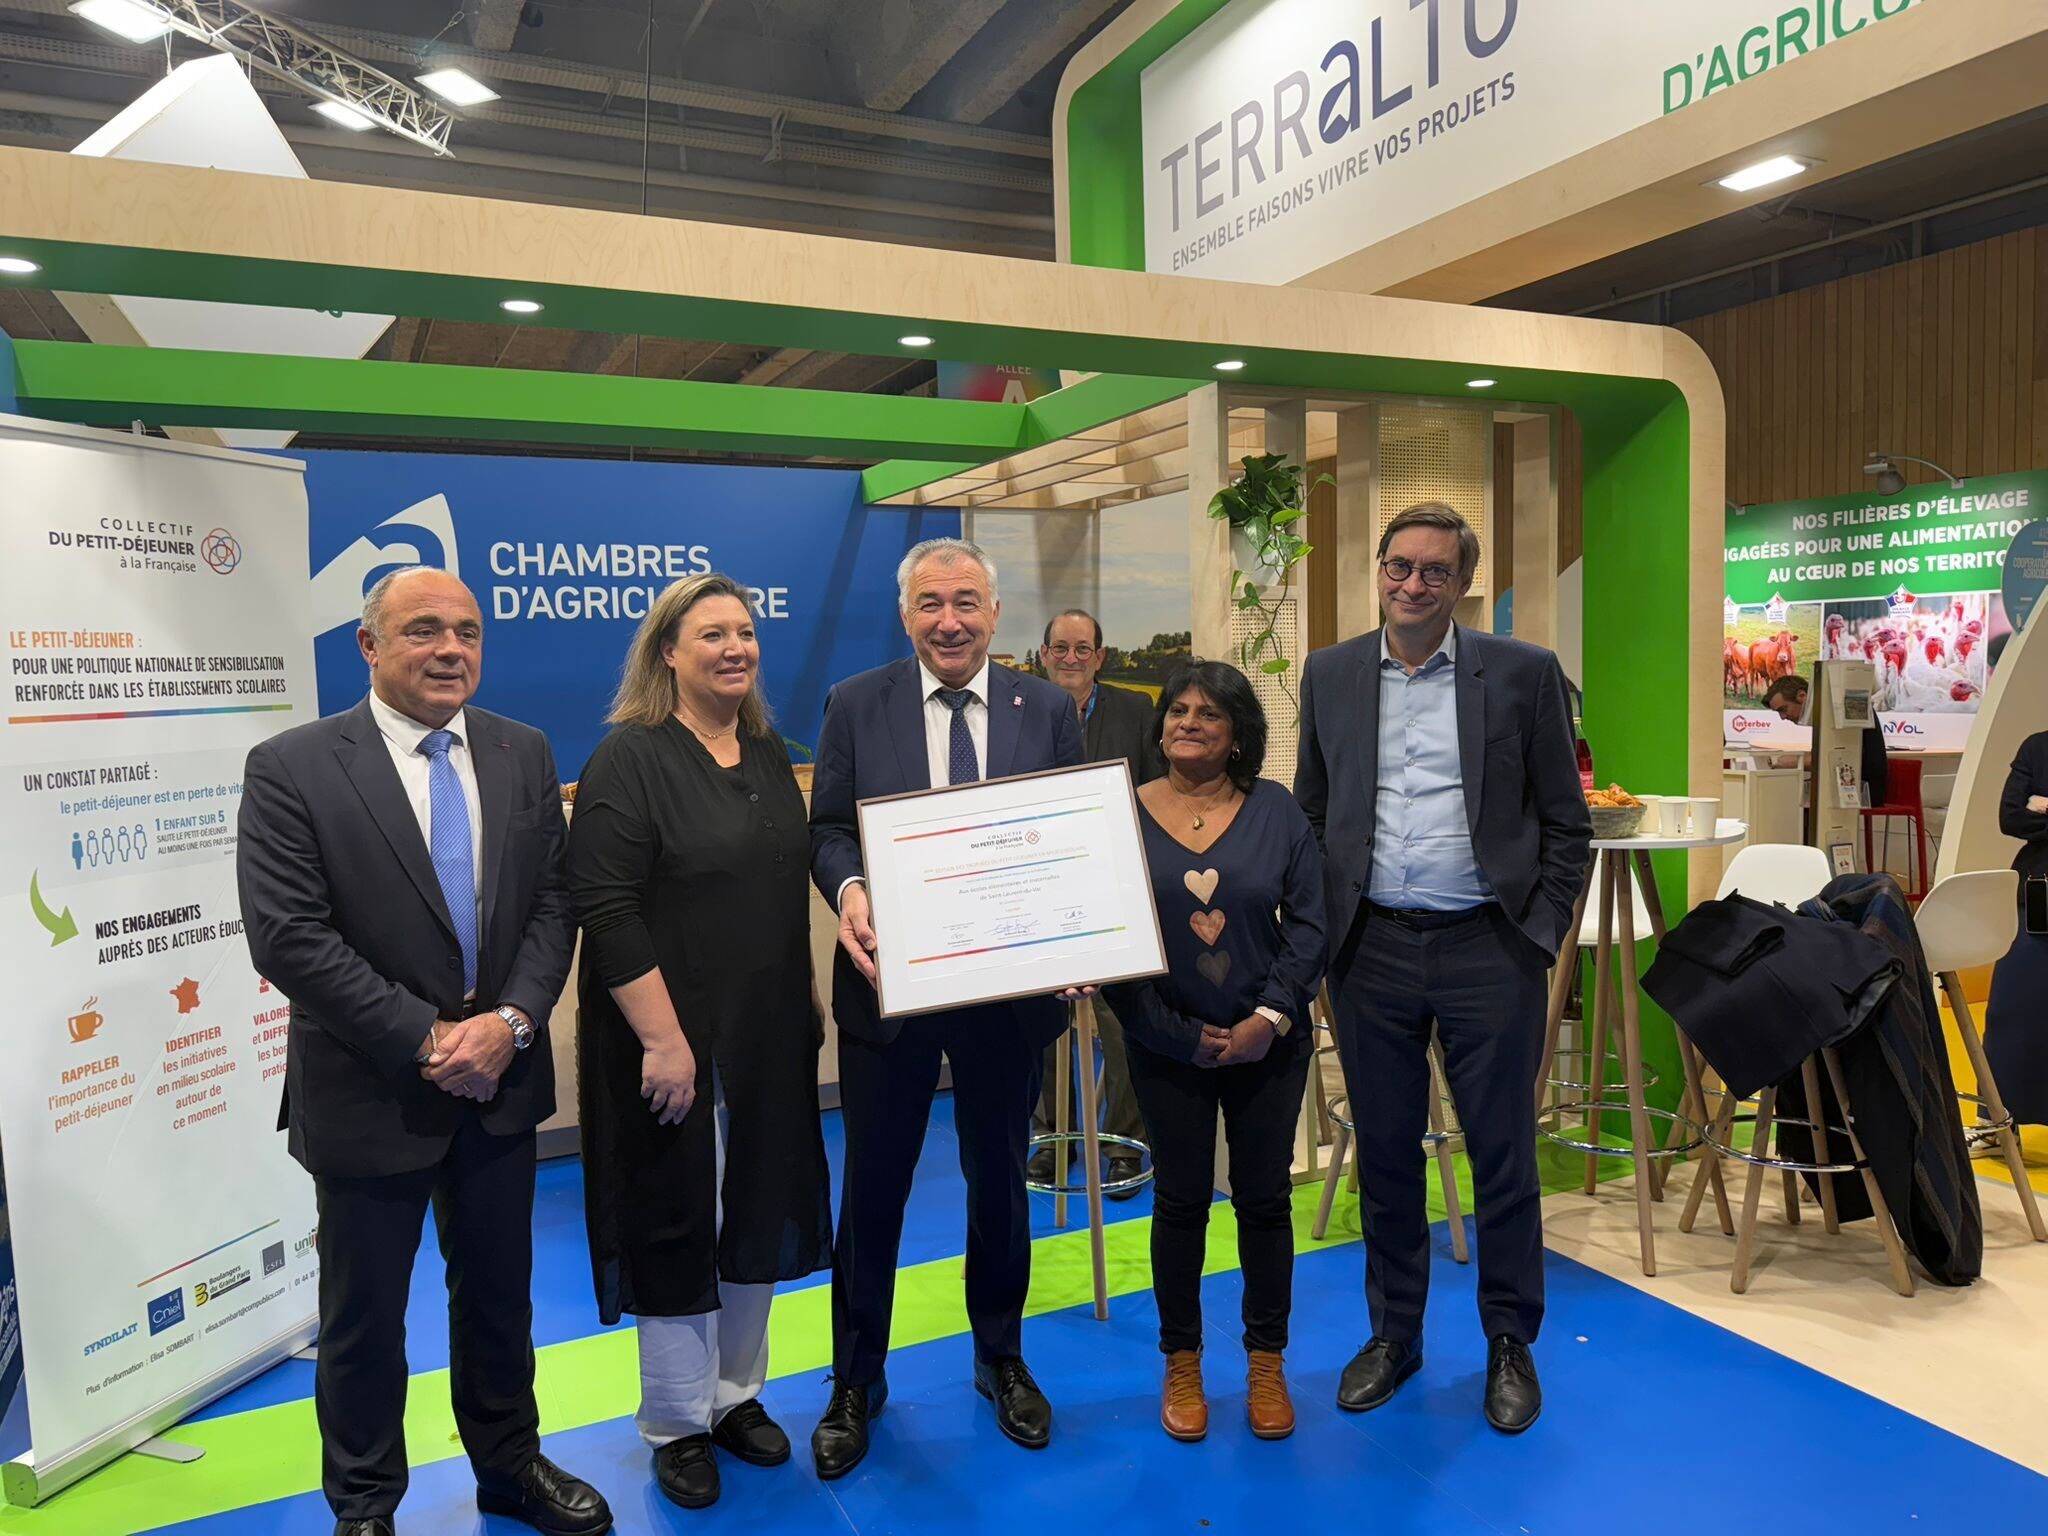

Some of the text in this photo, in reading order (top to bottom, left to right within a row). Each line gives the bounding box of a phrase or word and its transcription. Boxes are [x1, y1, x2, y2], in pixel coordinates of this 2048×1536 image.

[1173, 71, 1516, 272] ENSEMBLE FAISONS VIVRE VOS PROJETS
[1001, 379, 1028, 404] A
[100, 517, 194, 536] COLLECTIF
[1792, 512, 1828, 531] NOS
[1833, 502, 1911, 527] FILIÈRES
[49, 531, 195, 556] DU PETIT-DÉJEUNER
[1795, 537, 1842, 556] POUR
[1847, 533, 1884, 552] UNE
[1888, 517, 2038, 548] ALIMENTATIO
[120, 557, 197, 574] à la Française
[490, 541, 712, 578] CHAMBRES
[1767, 567, 1791, 584] AU
[1795, 563, 1847, 582] CŒUR
[1851, 560, 1875, 578] DE
[1880, 556, 1920, 576] NOS
[494, 585, 789, 620] D'AGRICRE
[10, 631, 27, 648] LE
[32, 629, 134, 649] PETIT-DÉJEUNER
[13, 656, 285, 675] POUR UNE POLITIQUE NATIONALE DE SENSIBILISATION
[16, 678, 287, 702] RENFORCÉE DANS LES ÉTABLISSEMENTS SCOLAIRES
[1735, 719, 1771, 730] interbev
[24, 774, 43, 792] UN
[47, 769, 96, 790] CONSTAT
[100, 761, 151, 784] PARTAGÉ
[60, 782, 245, 816] le petit-déjeuner est en perte de vite
[155, 810, 225, 831] 1 ENFANT SUR 5
[156, 825, 228, 843] SAUTE LE PETIT-DÉJEUNER
[158, 846, 167, 855] AU
[167, 843, 187, 854] MOINS
[187, 841, 199, 851] UNE
[199, 840, 213, 849] FOIS
[213, 837, 224, 847] PAR
[95, 904, 202, 940] NOS ENGAGEMENTS
[98, 938, 144, 965] AUPRÈS
[147, 935, 169, 955] DES
[172, 925, 216, 950] ACTEURS
[165, 1026, 222, 1054] IDENTIFIER
[252, 1033, 262, 1046] et
[163, 1045, 228, 1074] les initiatives
[257, 1049, 271, 1062] les
[61, 1055, 120, 1085] RAPPELER
[156, 1060, 237, 1097] en milieu scolaire
[49, 1071, 136, 1111] l'importance du
[175, 1083, 222, 1111] autour de
[54, 1094, 134, 1134] petit-déjeuner
[173, 1100, 228, 1131] ce moment
[209, 1264, 242, 1286] Boulangers
[209, 1268, 251, 1294] du Grand Paris
[152, 1299, 181, 1324] Cniel
[83, 1322, 138, 1357] SYNDILAIT
[86, 1384, 101, 1397] Plus
[102, 1361, 144, 1389] d'information
[150, 1350, 165, 1363] Elisa
[166, 1333, 195, 1355] SOMBART
